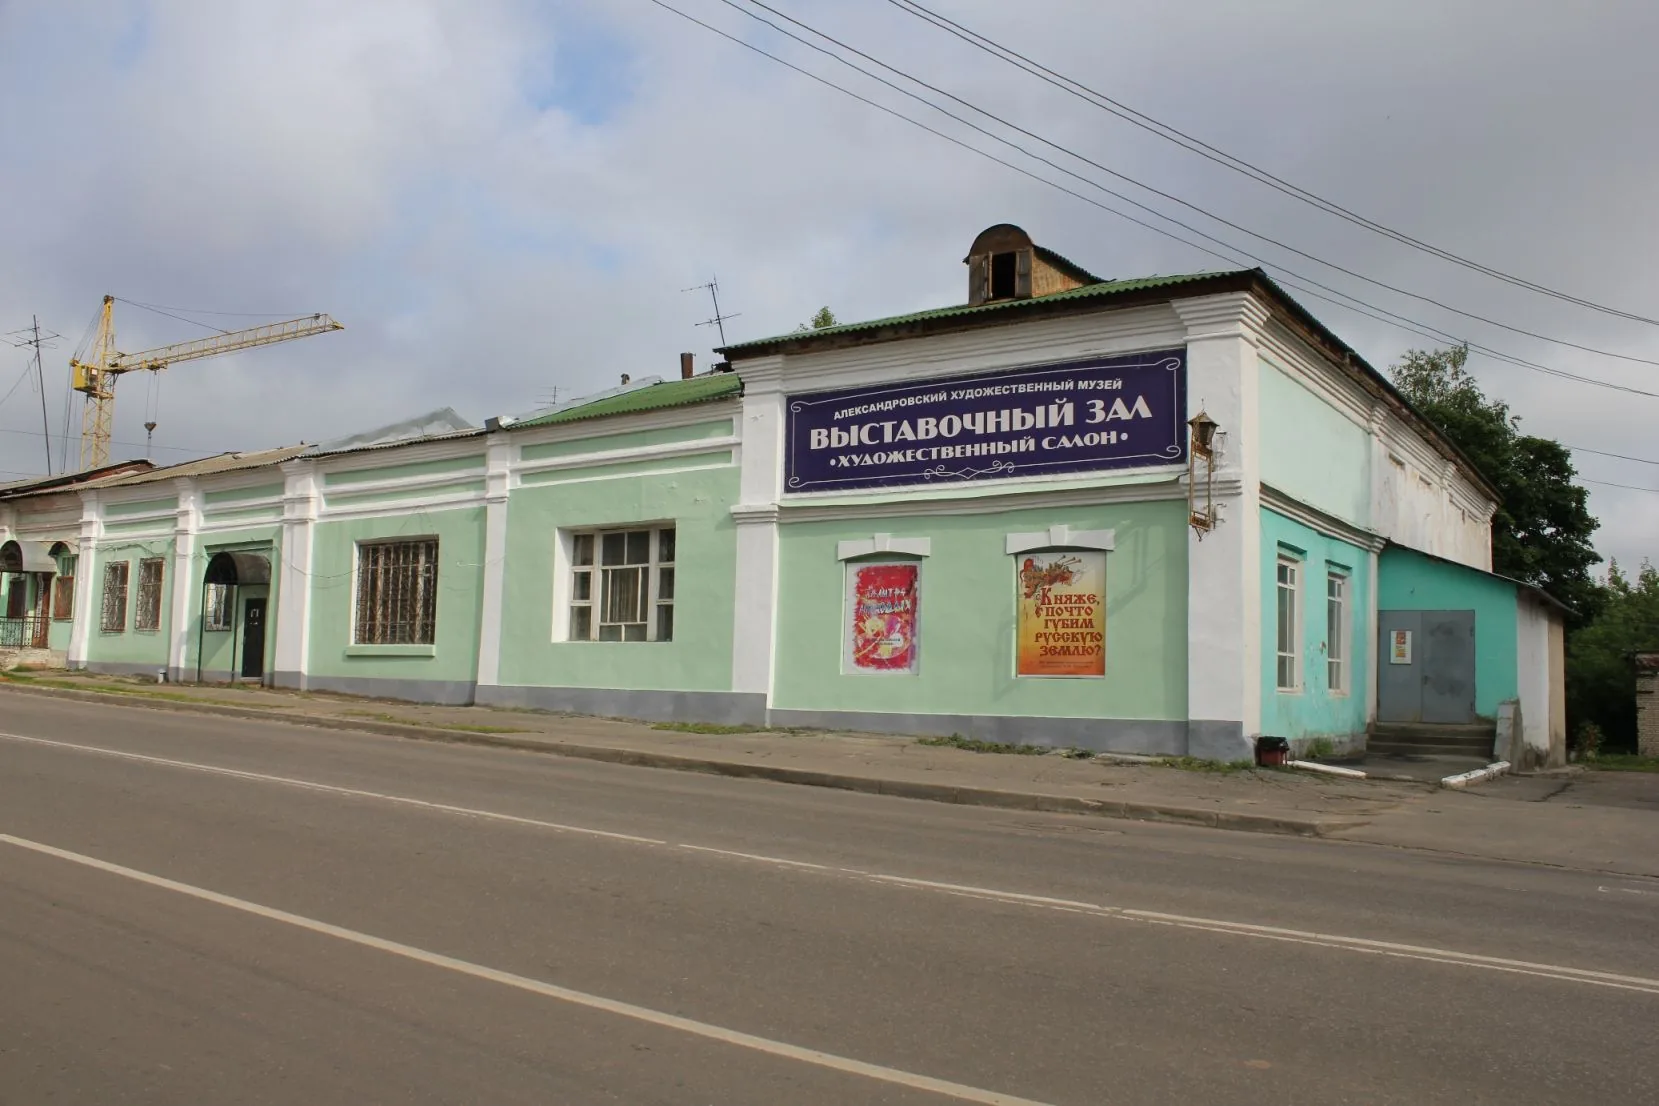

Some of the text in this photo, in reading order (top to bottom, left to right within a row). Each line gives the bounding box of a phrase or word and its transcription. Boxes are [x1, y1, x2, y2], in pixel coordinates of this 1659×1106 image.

[810, 395, 1153, 450] ВЫСТАВОЧНЫЙ ЗАЛ
[834, 378, 1122, 420] АЛЕКСАНДРОВСКИЙ ХУДОЖЕСТВЕННЫЙ МУЗЕЙ
